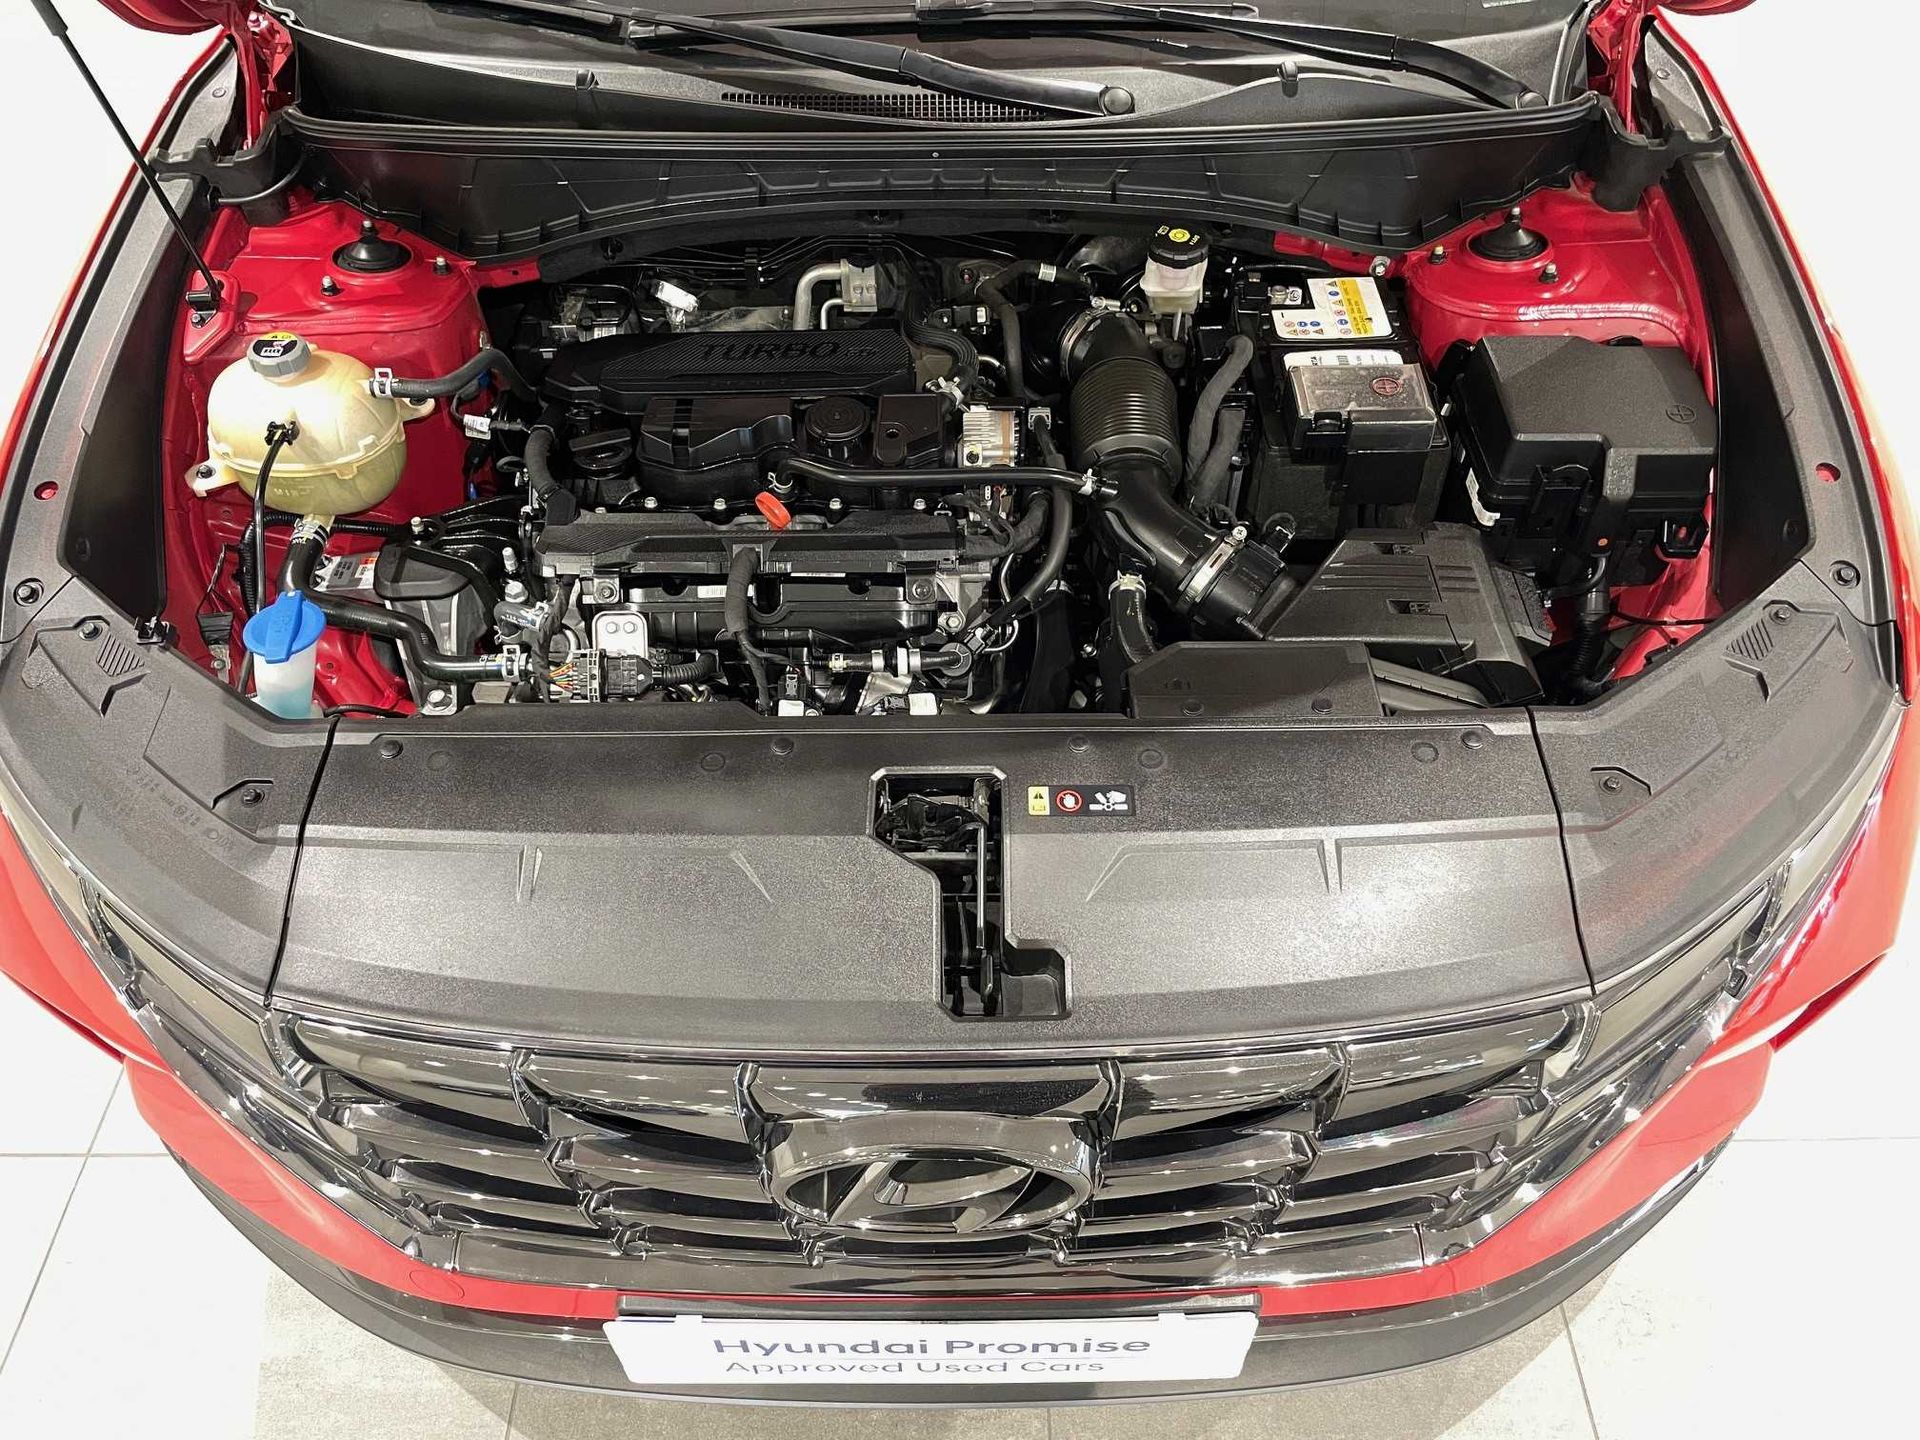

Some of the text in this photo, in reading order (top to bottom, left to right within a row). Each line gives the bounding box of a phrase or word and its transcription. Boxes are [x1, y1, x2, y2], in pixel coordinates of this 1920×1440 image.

[701, 341, 841, 361] TURBO
[713, 1338, 1151, 1356] Hyundai Promise
[726, 1361, 1105, 1375] Approved Used Cars
